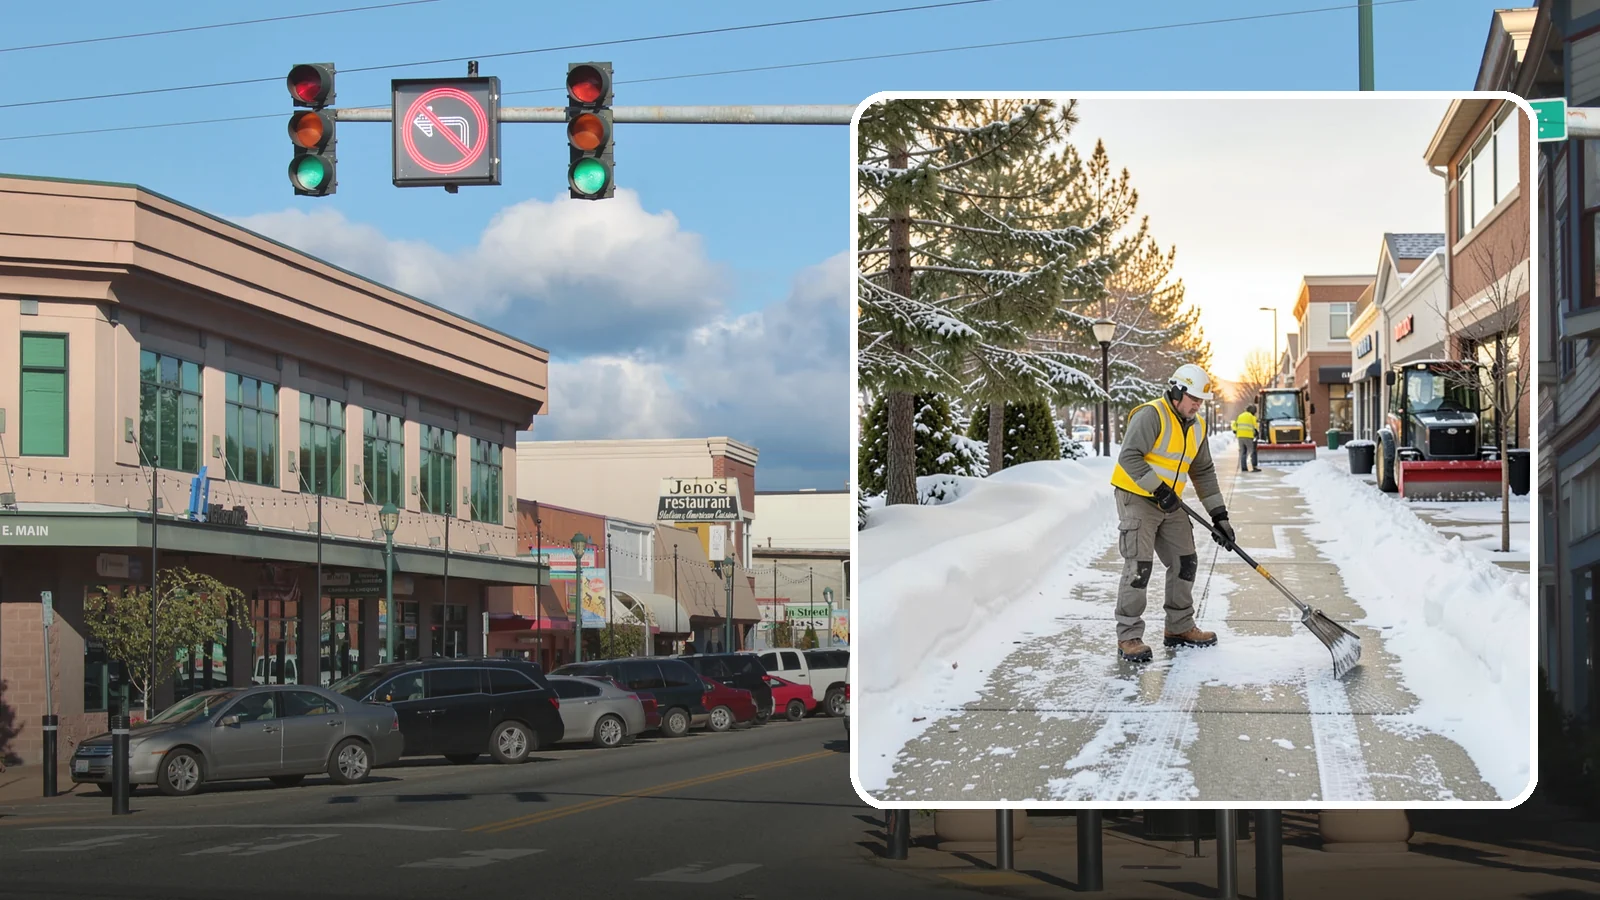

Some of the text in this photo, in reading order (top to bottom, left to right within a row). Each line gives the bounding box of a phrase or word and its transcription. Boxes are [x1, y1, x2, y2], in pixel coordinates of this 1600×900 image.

[669, 480, 728, 494] Jeno's
[665, 496, 731, 509] restaurant
[686, 509, 714, 519] American
[715, 509, 738, 519] Cuisine
[2, 525, 49, 536] E. MAIN
[797, 607, 829, 617] Street
